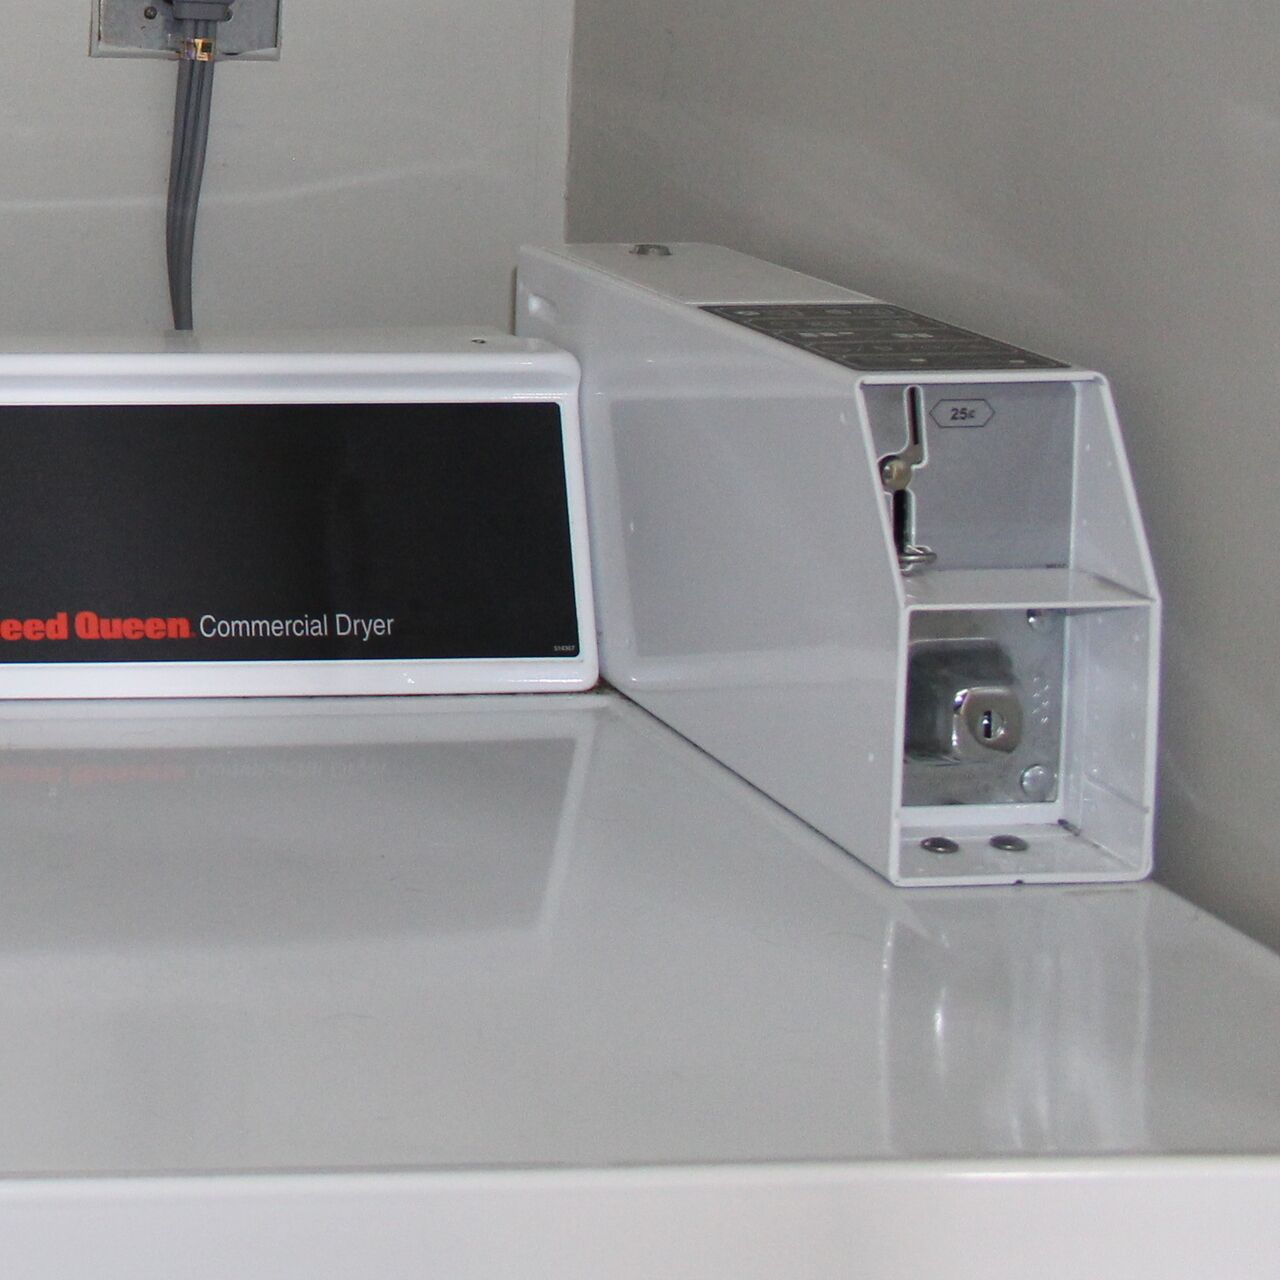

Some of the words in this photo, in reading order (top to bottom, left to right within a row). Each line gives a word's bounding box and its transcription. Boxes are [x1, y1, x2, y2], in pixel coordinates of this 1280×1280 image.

[74, 610, 191, 640] Queen
[199, 615, 329, 640] Commercial
[336, 614, 395, 640] Dryer
